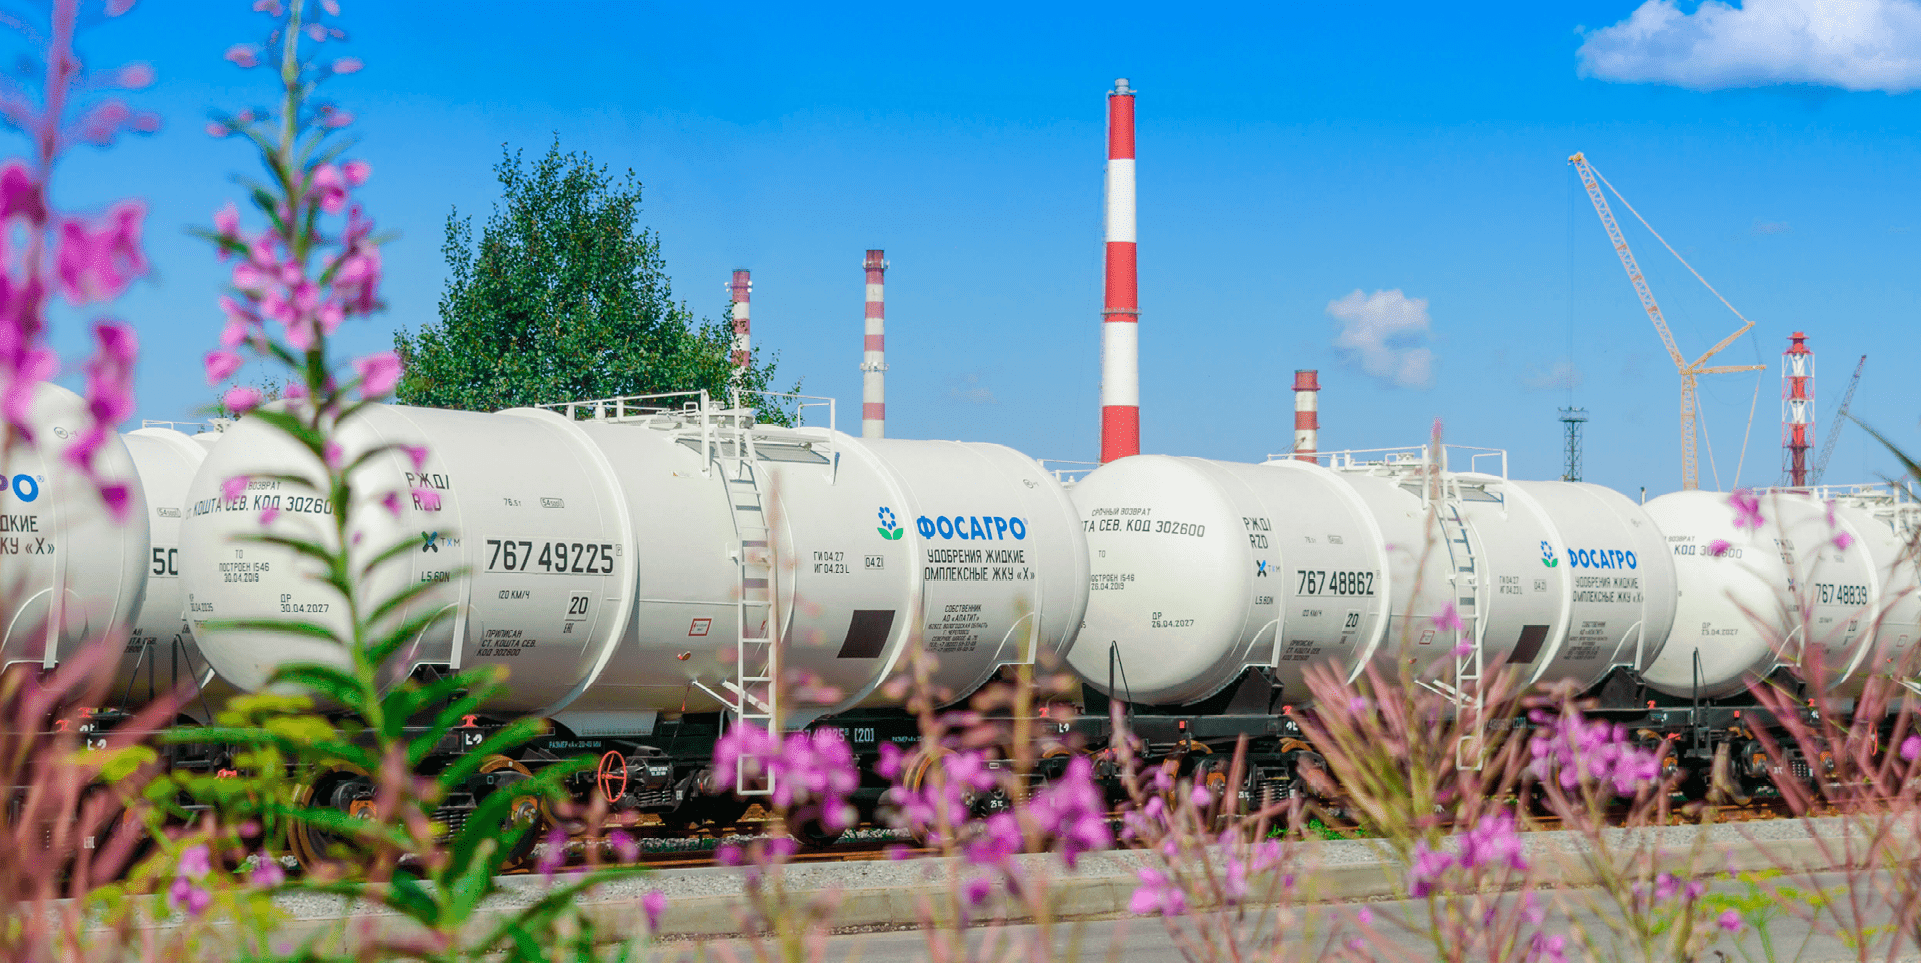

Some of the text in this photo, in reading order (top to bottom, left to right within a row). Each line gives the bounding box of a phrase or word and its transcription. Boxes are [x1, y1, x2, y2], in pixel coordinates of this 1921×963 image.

[248, 481, 280, 490] ВОЗВРАТ
[194, 497, 222, 516] КОШТА
[226, 495, 248, 511] СЕВ.
[254, 495, 280, 511] КОД
[412, 493, 441, 511] RD
[1092, 507, 1151, 516] СРОЧНЫЙ ВОЗВРАТ
[916, 515, 1026, 540] ФОСАГРО
[1099, 519, 1122, 532] СЕВ.
[1126, 520, 1150, 532] КОД
[1155, 520, 1205, 538] 302600
[1249, 534, 1268, 549] RZD
[236, 550, 243, 559] ТО
[927, 549, 1025, 564] УДОБРЕНИЯ ЖИДКИЕ
[1098, 550, 1106, 558] ТО
[1674, 545, 1742, 559] КОД 30600
[865, 557, 883, 568] 04.21
[219, 563, 269, 572] ПОСТРОЕН 1546
[224, 573, 259, 582] 30.04.2019
[924, 567, 988, 581] ОМПЛЕКСНЫЕ
[992, 567, 1014, 581] ЖКУ
[1091, 582, 1124, 590] 26.04.2019
[280, 594, 291, 602] ДР
[511, 590, 530, 599] КМ/Ч
[280, 604, 329, 613] 30.04.2027
[569, 596, 588, 614] 20
[945, 604, 982, 613] СОБСТВЕННИК
[1152, 612, 1162, 620] ДР
[1345, 613, 1359, 628] 20
[1152, 620, 1194, 628] 26.04.2027
[486, 629, 523, 638] ПРИПИСАН
